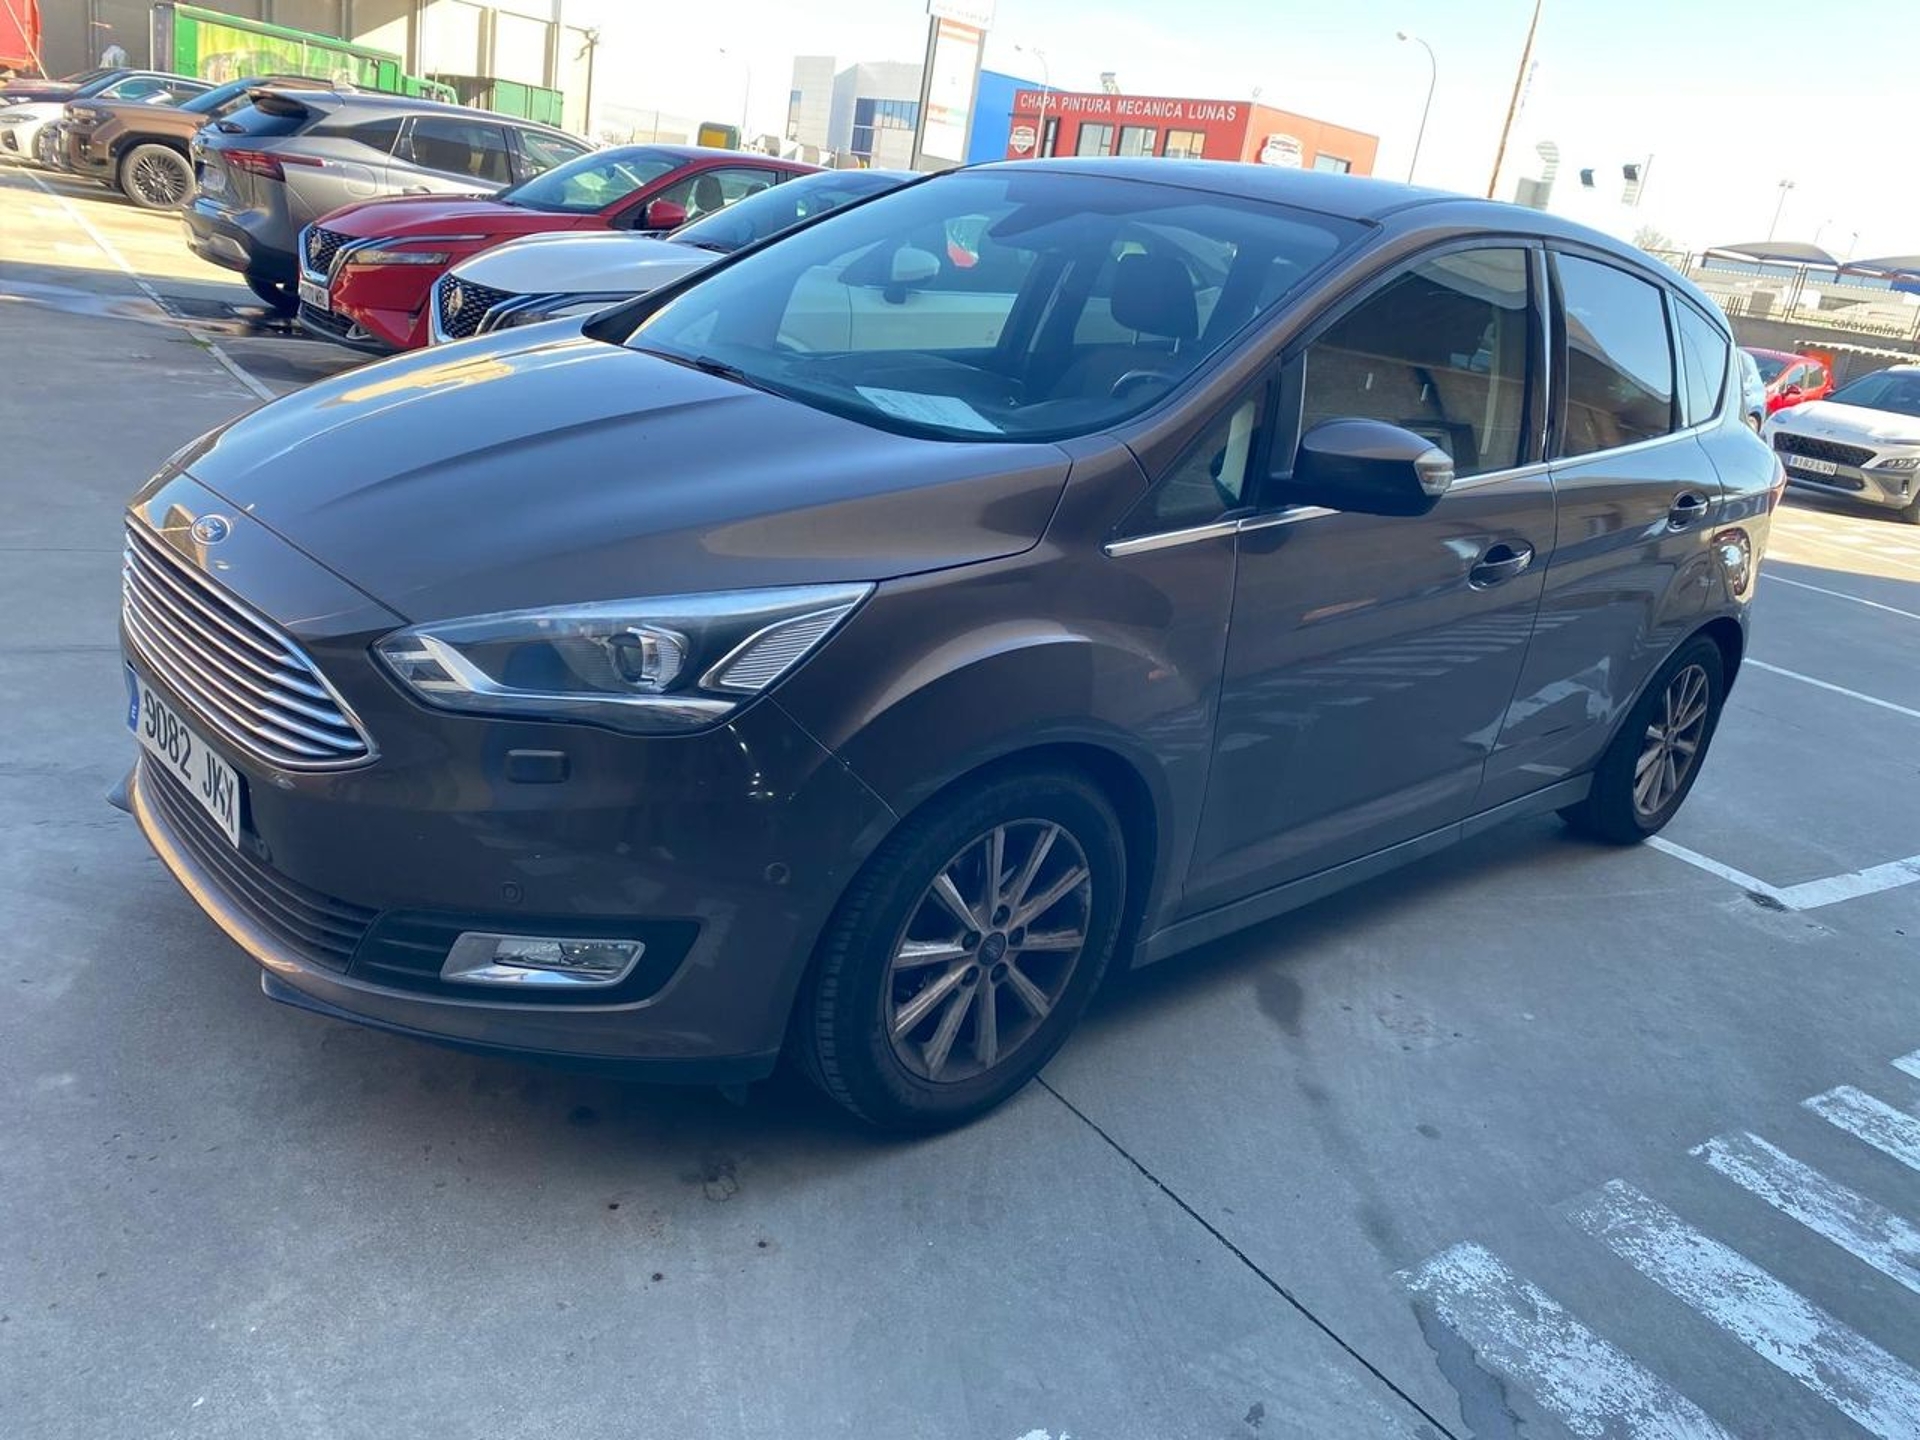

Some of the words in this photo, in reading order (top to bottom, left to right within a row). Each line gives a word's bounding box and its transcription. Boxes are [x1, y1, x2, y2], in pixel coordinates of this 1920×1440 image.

[1020, 93, 1057, 109] CHAPA
[1061, 97, 1112, 114] PINTURA
[1116, 100, 1183, 118] MECANICA
[1188, 105, 1237, 122] LUNAS
[145, 689, 192, 781] 9082
[203, 751, 235, 833] JKX
